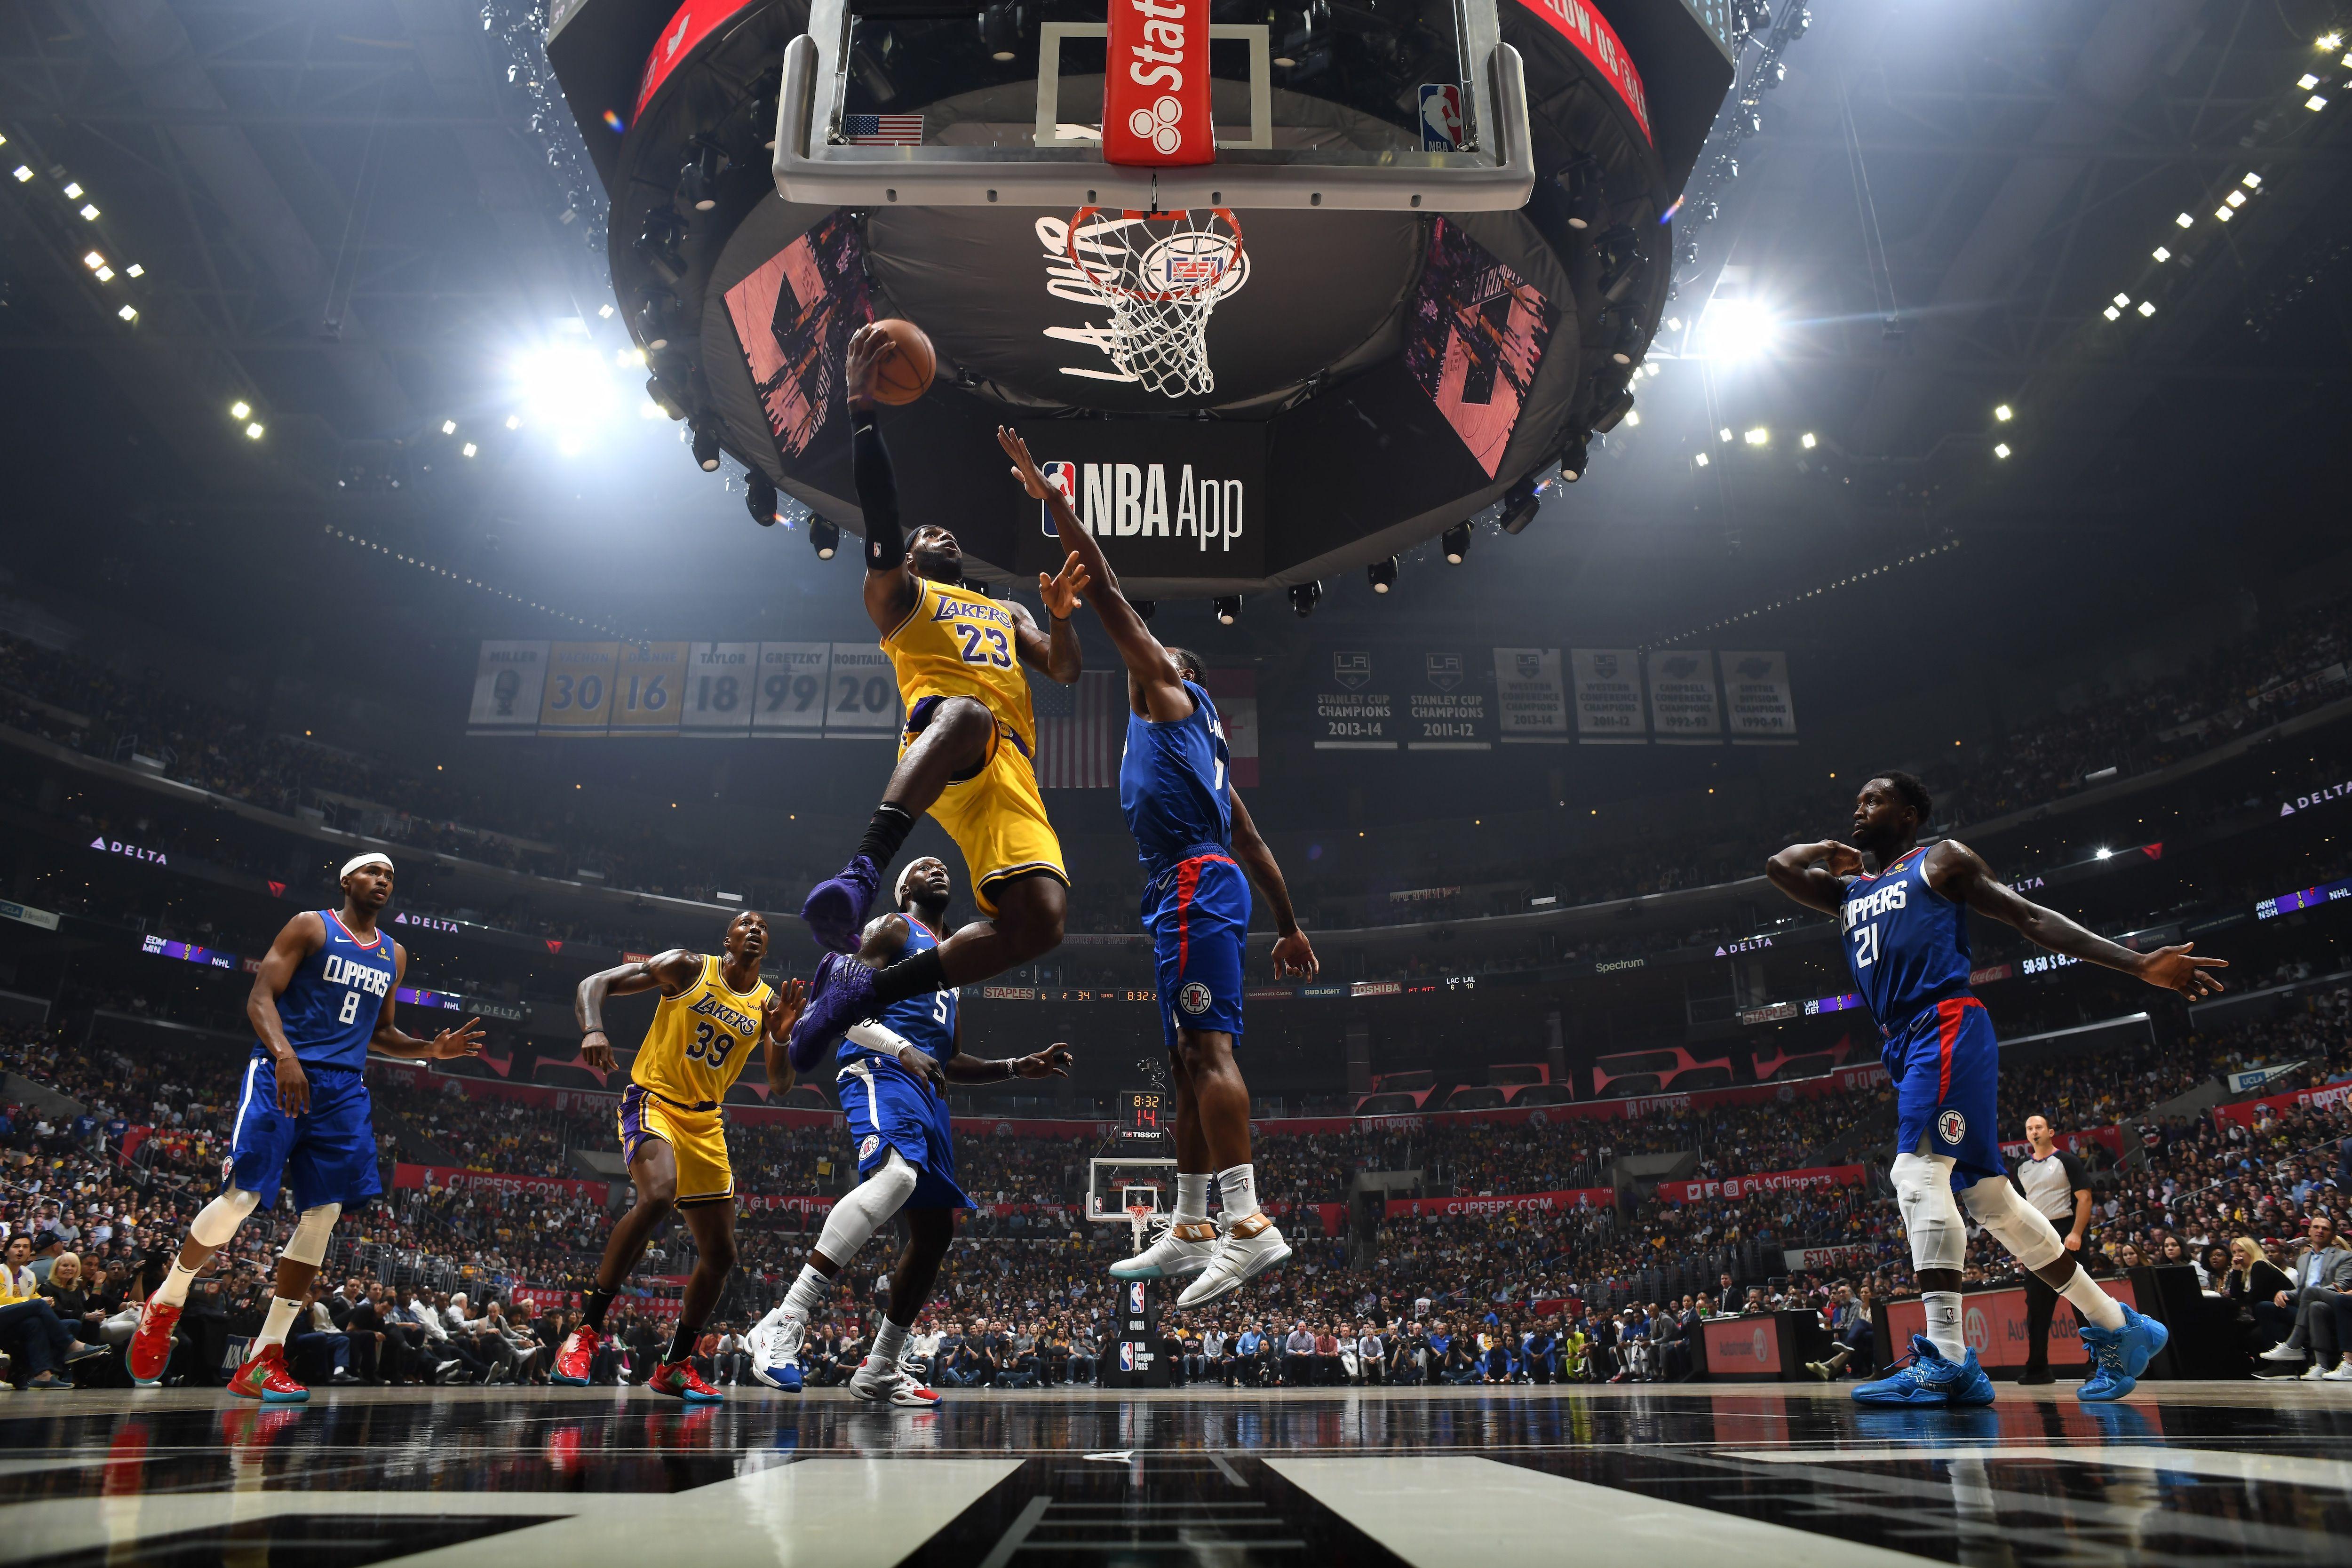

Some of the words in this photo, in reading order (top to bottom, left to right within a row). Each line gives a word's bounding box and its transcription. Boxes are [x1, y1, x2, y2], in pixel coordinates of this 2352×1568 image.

[1130, 0, 1185, 91] Stat
[1595, 22, 1619, 77] US
[1428, 141, 1444, 152] NBA
[1084, 463, 1169, 536] NBA
[1175, 464, 1243, 551] App
[930, 595, 1012, 629] LAKERS
[956, 623, 1013, 671] 23
[490, 651, 538, 662] MILLER
[700, 653, 746, 664] TAYLOR
[765, 653, 822, 664] GRETZKY
[834, 654, 892, 665] ROBITAILL
[552, 674, 605, 712] 30
[627, 675, 668, 712] 16
[1586, 683, 1629, 692] WESTERN
[698, 676, 739, 712] 18
[764, 675, 819, 713] 99
[835, 676, 891, 714] 20
[1317, 694, 1364, 705] STANLEY
[1367, 694, 1390, 704] CUP
[1411, 695, 1457, 705] STANLEY
[1460, 695, 1483, 705] CUP
[1318, 706, 1391, 717] CHAMPIONS
[1411, 707, 1484, 718] CHAMPIONS
[1506, 703, 1558, 711] CHAMPIONS
[1584, 703, 1637, 712] CHAMPIONS
[1514, 715, 1552, 725] 2013-14
[1593, 716, 1630, 726] 2011-12
[1328, 722, 1382, 735] 2013-14
[1423, 723, 1474, 736] 2011-12
[2297, 781, 2352, 809] DELTA
[111, 841, 167, 865] DELTA
[1886, 867, 1908, 877] bumble
[2007, 876, 2045, 892] ELTA
[2329, 888, 2352, 900] NHL
[1840, 880, 1908, 935] CLIPPERS
[2256, 899, 2276, 911] ANH
[2258, 907, 2279, 920] NSH
[412, 915, 458, 933] DELTA
[145, 935, 167, 947] EDM
[1730, 938, 1773, 953] DELTA
[1854, 922, 1878, 969] 21
[143, 943, 161, 954] MIN
[377, 952, 391, 961] bumble
[212, 957, 230, 969] NHL
[1596, 959, 1644, 973] Spectrum
[2023, 956, 2048, 974] 50-50
[322, 955, 390, 998] CLIPPERS
[984, 988, 1033, 999] STAPLES
[1351, 984, 1400, 995] TOSHIBA
[1078, 992, 1089, 1000] 34
[1127, 991, 1148, 1001] 8:32
[339, 990, 361, 1025] 8
[444, 1001, 461, 1011] NHL
[483, 1005, 521, 1018] DELTA
[747, 1001, 762, 1012] wish
[933, 990, 949, 1025] 5
[1805, 1006, 1820, 1015] DET
[688, 991, 757, 1036] LAKERS
[1743, 1004, 1796, 1024] STAPLES
[686, 1020, 735, 1070] 39
[2242, 1075, 2263, 1085] UCLA
[1133, 1095, 1159, 1107] 8:32
[1137, 1110, 1155, 1127] 14
[750, 1197, 833, 1216] @LAClipp
[1447, 1197, 1552, 1215] CLIPPERS.COM
[1248, 1217, 1264, 1231] N
[1186, 1226, 1203, 1239] N
[1418, 1305, 1426, 1313] 32
[1129, 1321, 1145, 1330] @NBA
[1135, 1342, 1145, 1352] NBA
[1135, 1353, 1154, 1362] League
[1135, 1361, 1148, 1370] Pass
